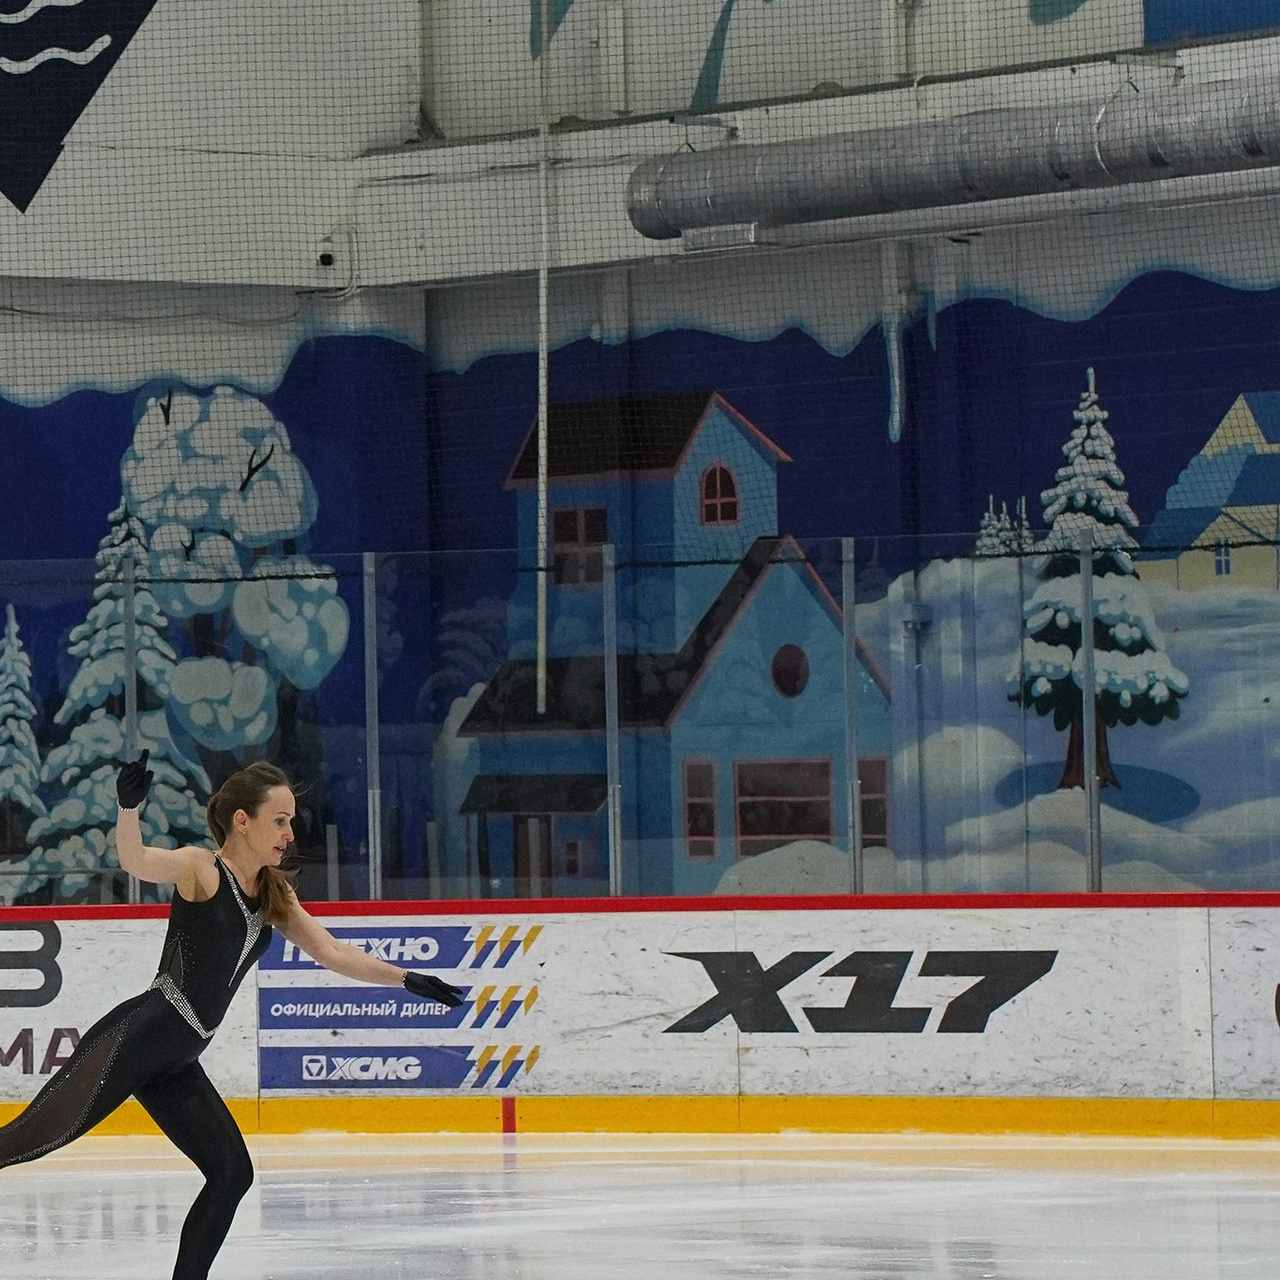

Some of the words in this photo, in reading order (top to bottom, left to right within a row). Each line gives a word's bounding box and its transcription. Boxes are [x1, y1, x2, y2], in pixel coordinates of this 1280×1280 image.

[661, 950, 1059, 1034] X17
[270, 1000, 397, 1018] ОФИЦИАЛЬНЫЙ
[400, 1001, 451, 1018] ДИЛЕР
[328, 1056, 422, 1080] XCMG
